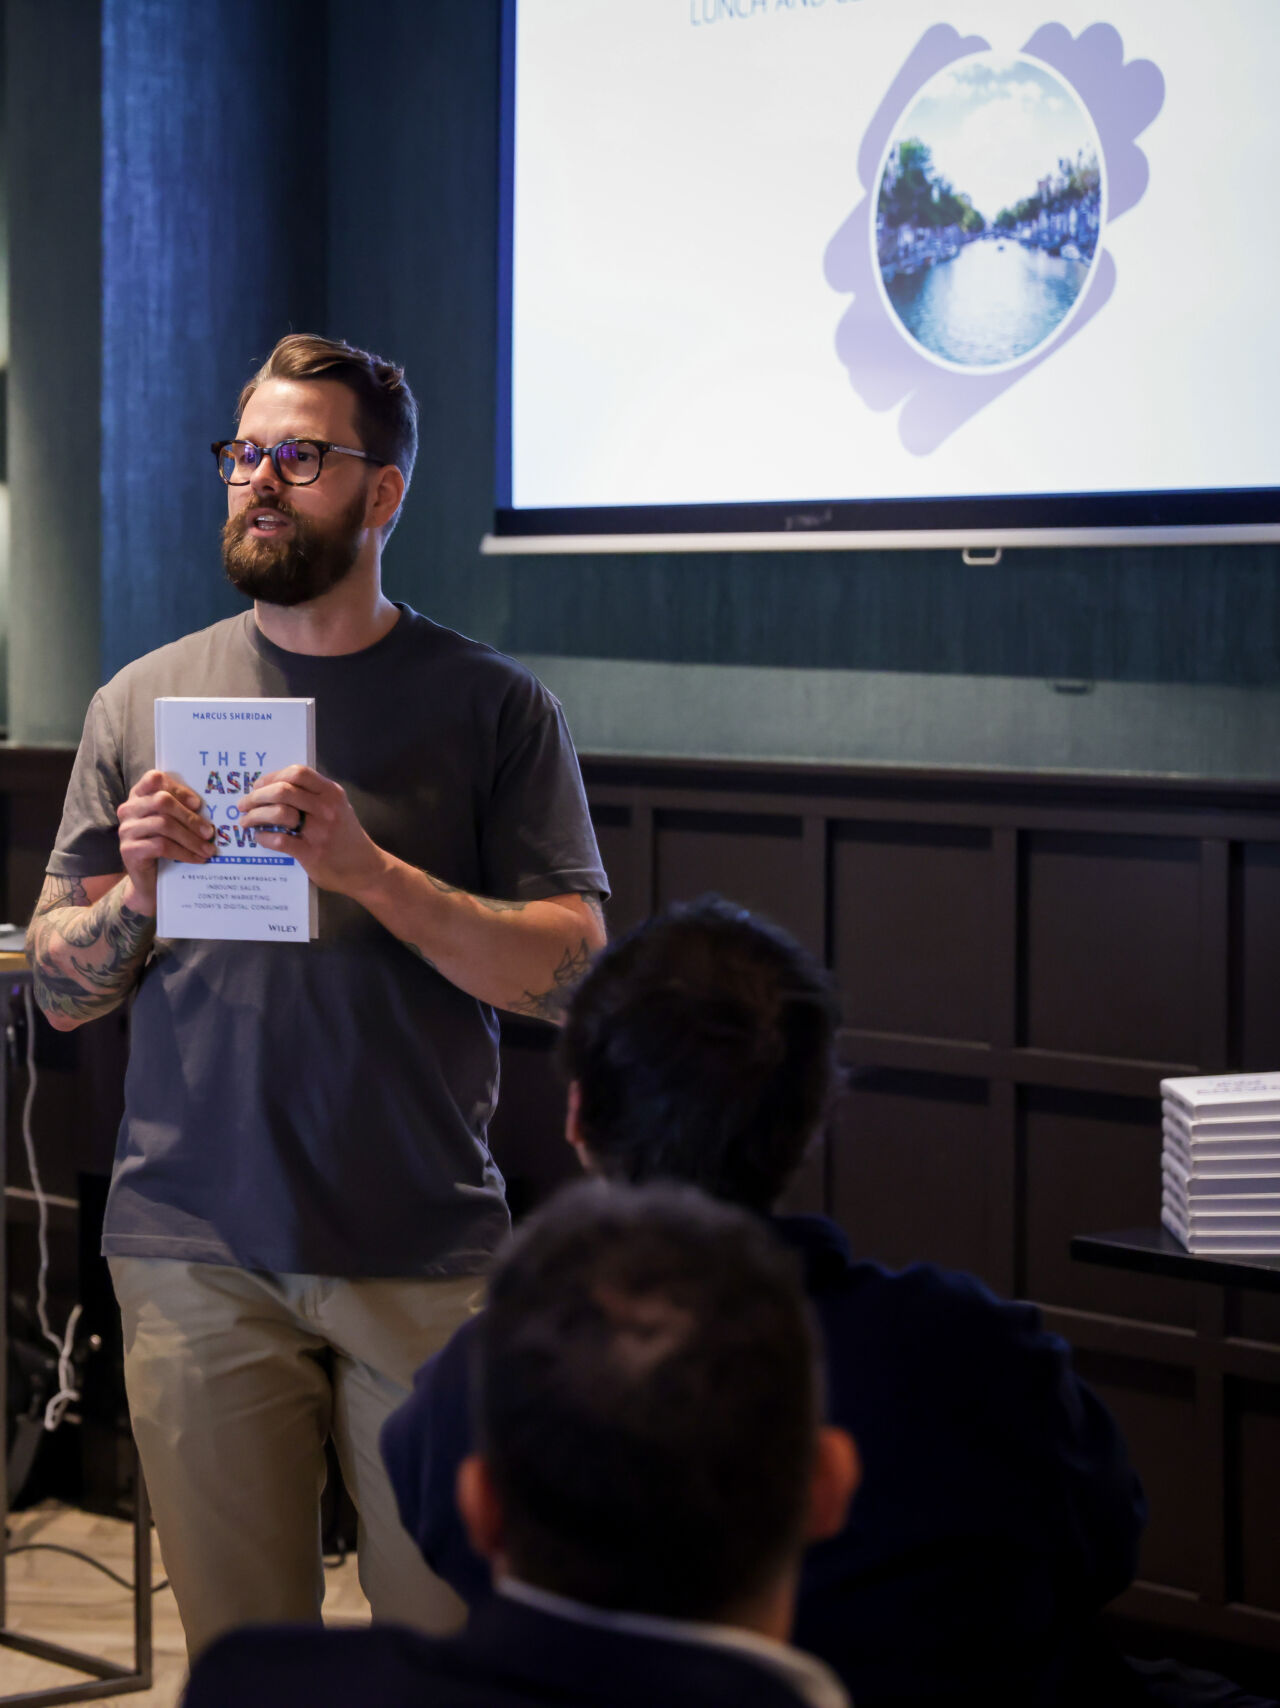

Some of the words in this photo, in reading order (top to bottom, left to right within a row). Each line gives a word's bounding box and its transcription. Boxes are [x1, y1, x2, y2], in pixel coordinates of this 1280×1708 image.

[192, 712, 227, 720] MARCUS
[230, 712, 272, 720] SHERIDAN
[199, 751, 267, 767] THEY
[205, 771, 262, 794] ASK
[206, 805, 240, 820] YO
[268, 924, 297, 933] WILEY
